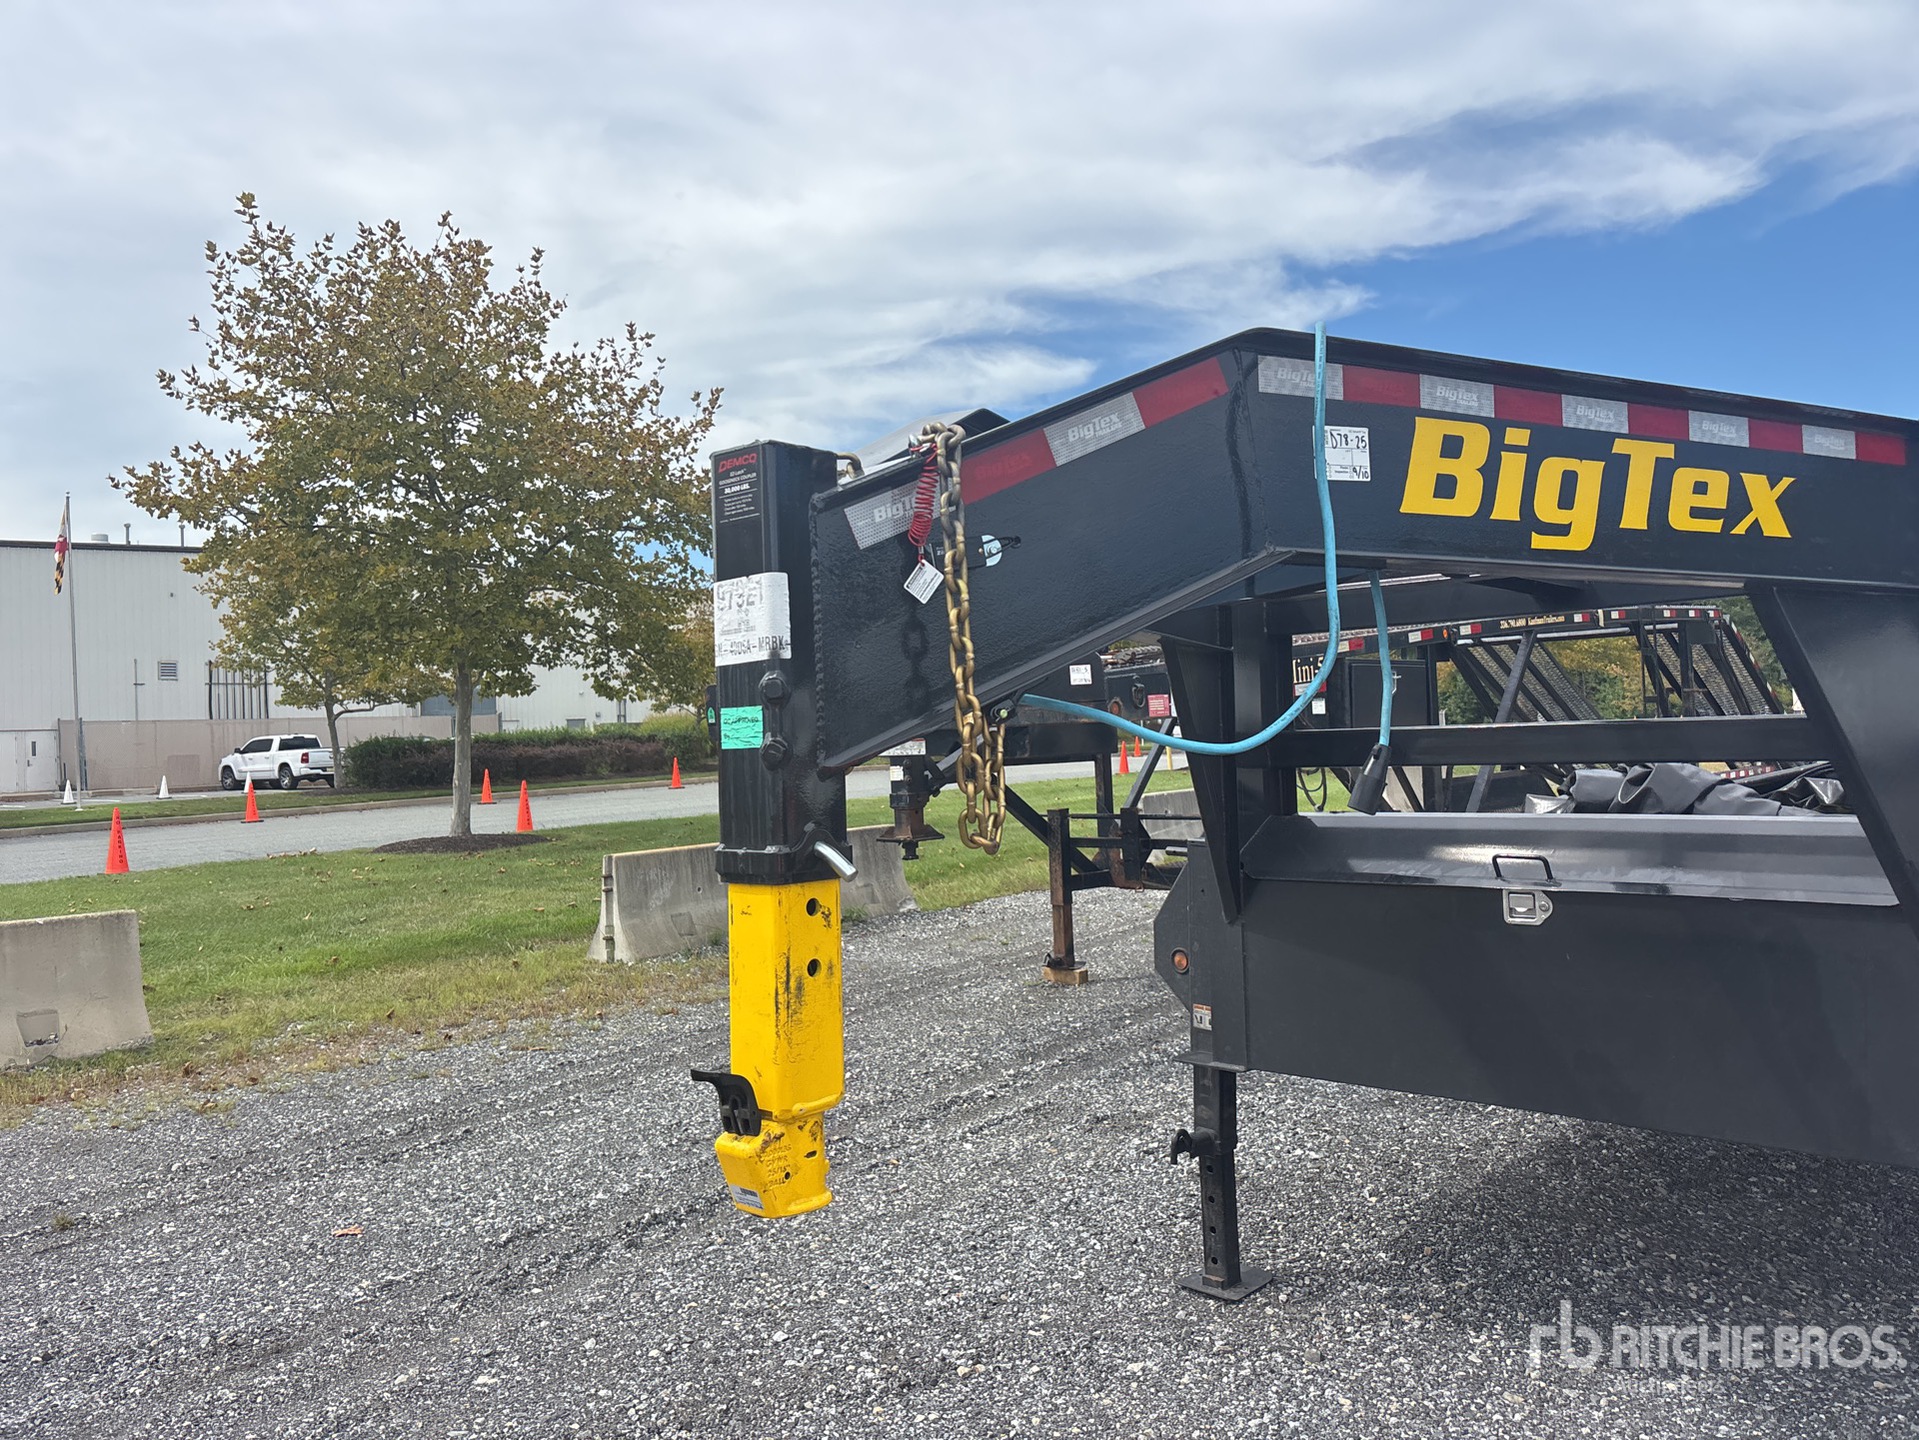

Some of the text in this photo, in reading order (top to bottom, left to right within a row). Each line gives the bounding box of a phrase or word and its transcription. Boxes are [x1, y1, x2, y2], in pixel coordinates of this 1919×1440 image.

[1436, 384, 1479, 402] BigTex
[1576, 404, 1616, 420] BigTex
[1067, 411, 1120, 443] BigTex
[1701, 419, 1737, 434] BigTex
[718, 453, 757, 473] DEMCO
[1400, 416, 1797, 551] BigTex
